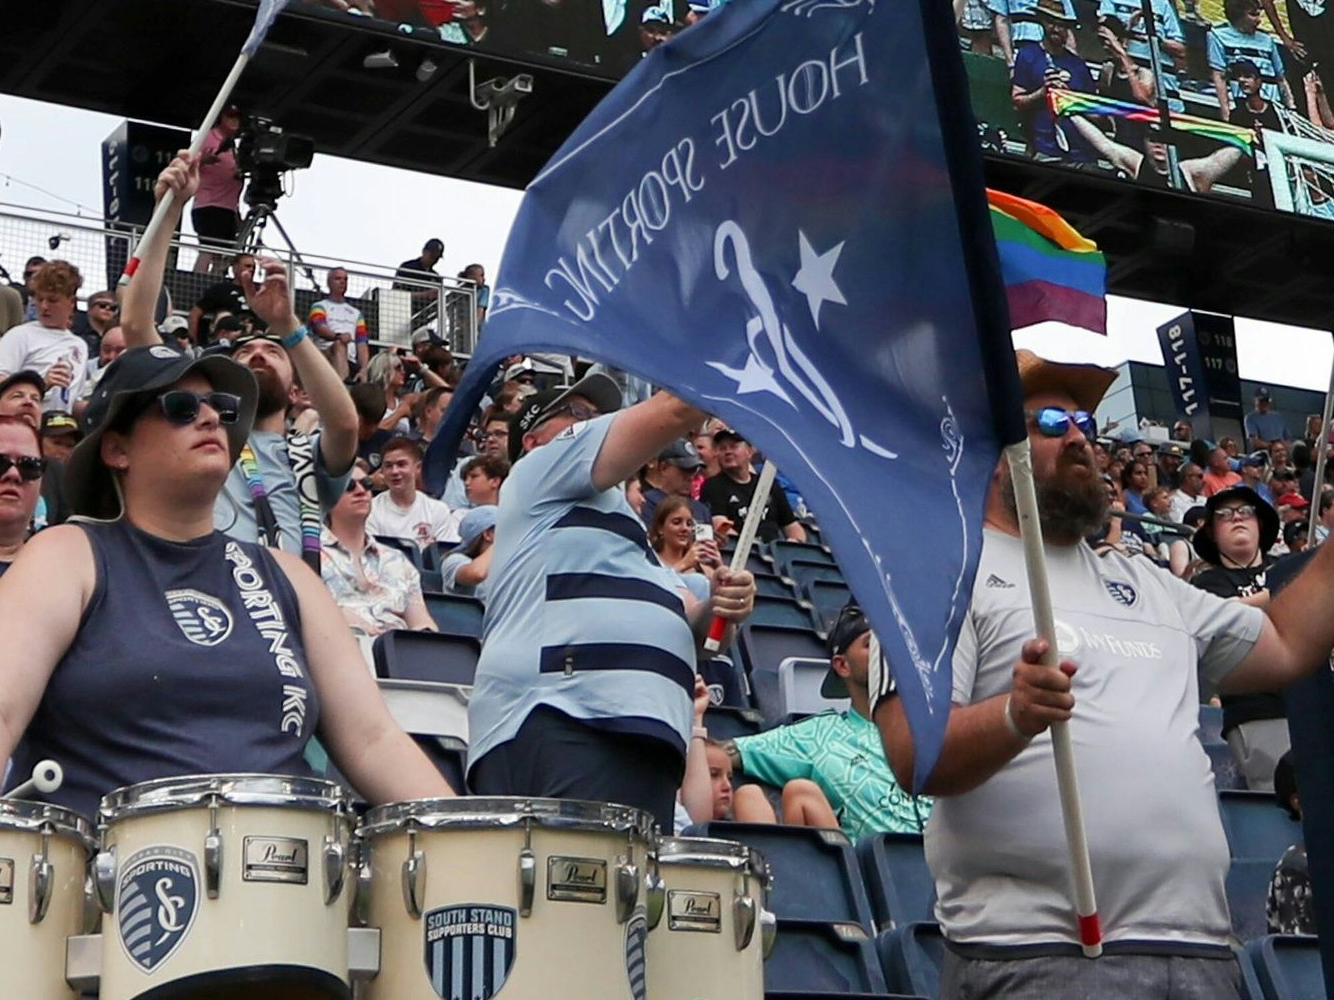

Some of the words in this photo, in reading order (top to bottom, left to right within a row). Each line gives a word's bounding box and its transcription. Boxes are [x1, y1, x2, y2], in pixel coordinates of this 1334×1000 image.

[1168, 325, 1198, 416] 117-118
[1205, 356, 1223, 370] 117
[519, 403, 542, 432] SKC
[1103, 634, 1163, 659] FUNDS
[280, 683, 307, 738] KC
[259, 843, 299, 864] Pearl
[121, 860, 192, 889] SPORTING
[563, 863, 598, 886] Pearl
[684, 896, 713, 916] Pearl
[427, 908, 467, 929] SOUTH
[469, 907, 513, 928] STAND
[427, 923, 486, 943] SUPPORTERS
[487, 922, 513, 939] CLUB
